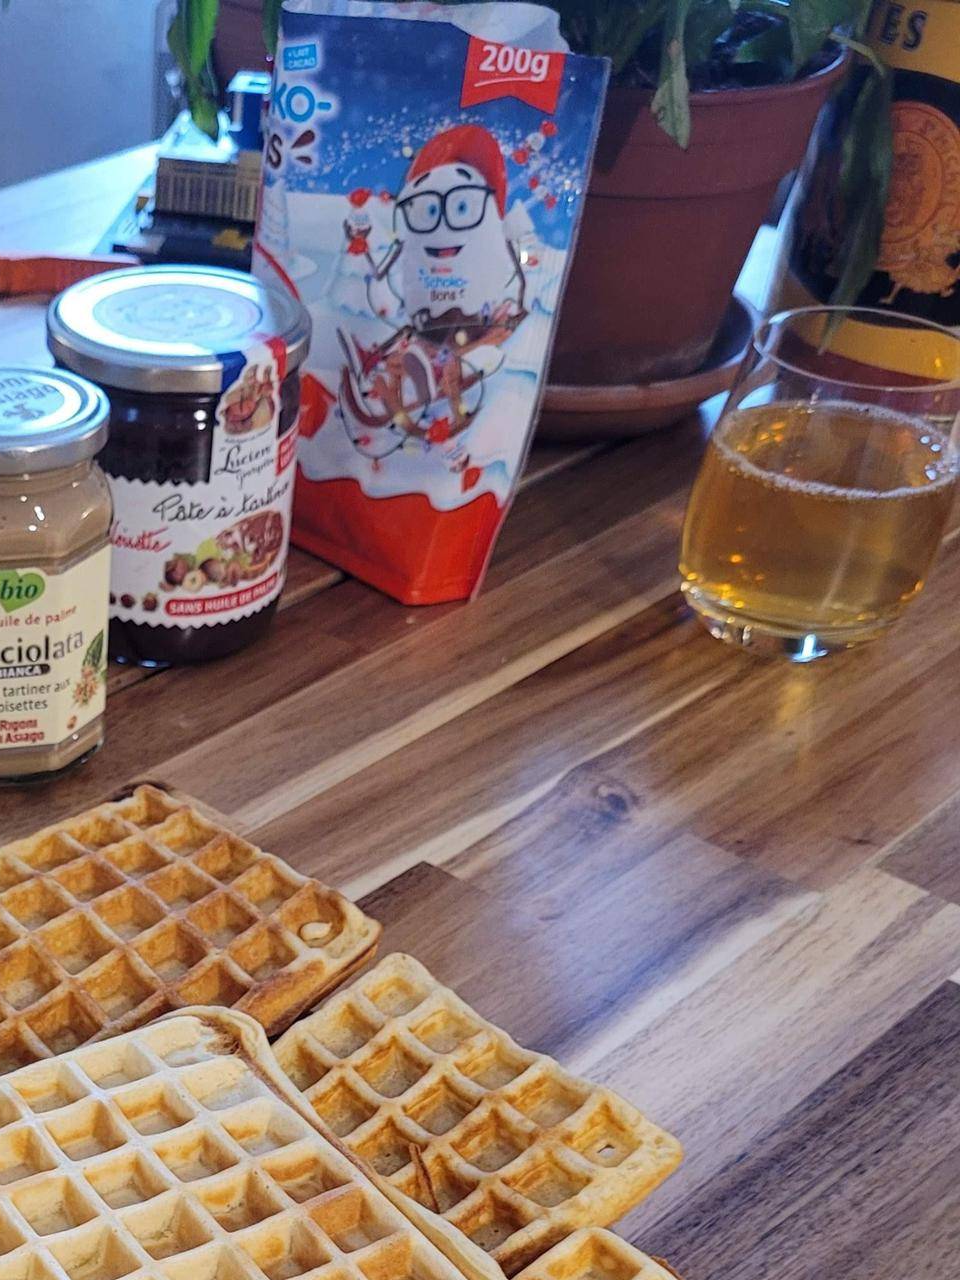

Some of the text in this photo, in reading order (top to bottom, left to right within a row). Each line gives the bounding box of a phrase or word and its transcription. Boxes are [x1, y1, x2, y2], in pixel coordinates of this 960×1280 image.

[478, 45, 550, 82] 200g
[214, 444, 271, 475] Lucien
[151, 493, 214, 522] Pâte
[214, 495, 234, 520] à
[0, 578, 38, 600] bio
[24, 614, 41, 626] de
[45, 605, 78, 627] palme
[169, 600, 203, 614] SANS
[204, 597, 239, 613] HUILE
[3, 683, 52, 698] tartiner
[54, 678, 71, 693] aux
[0, 719, 38, 732] Rigoni
[6, 731, 45, 744] Asiago
